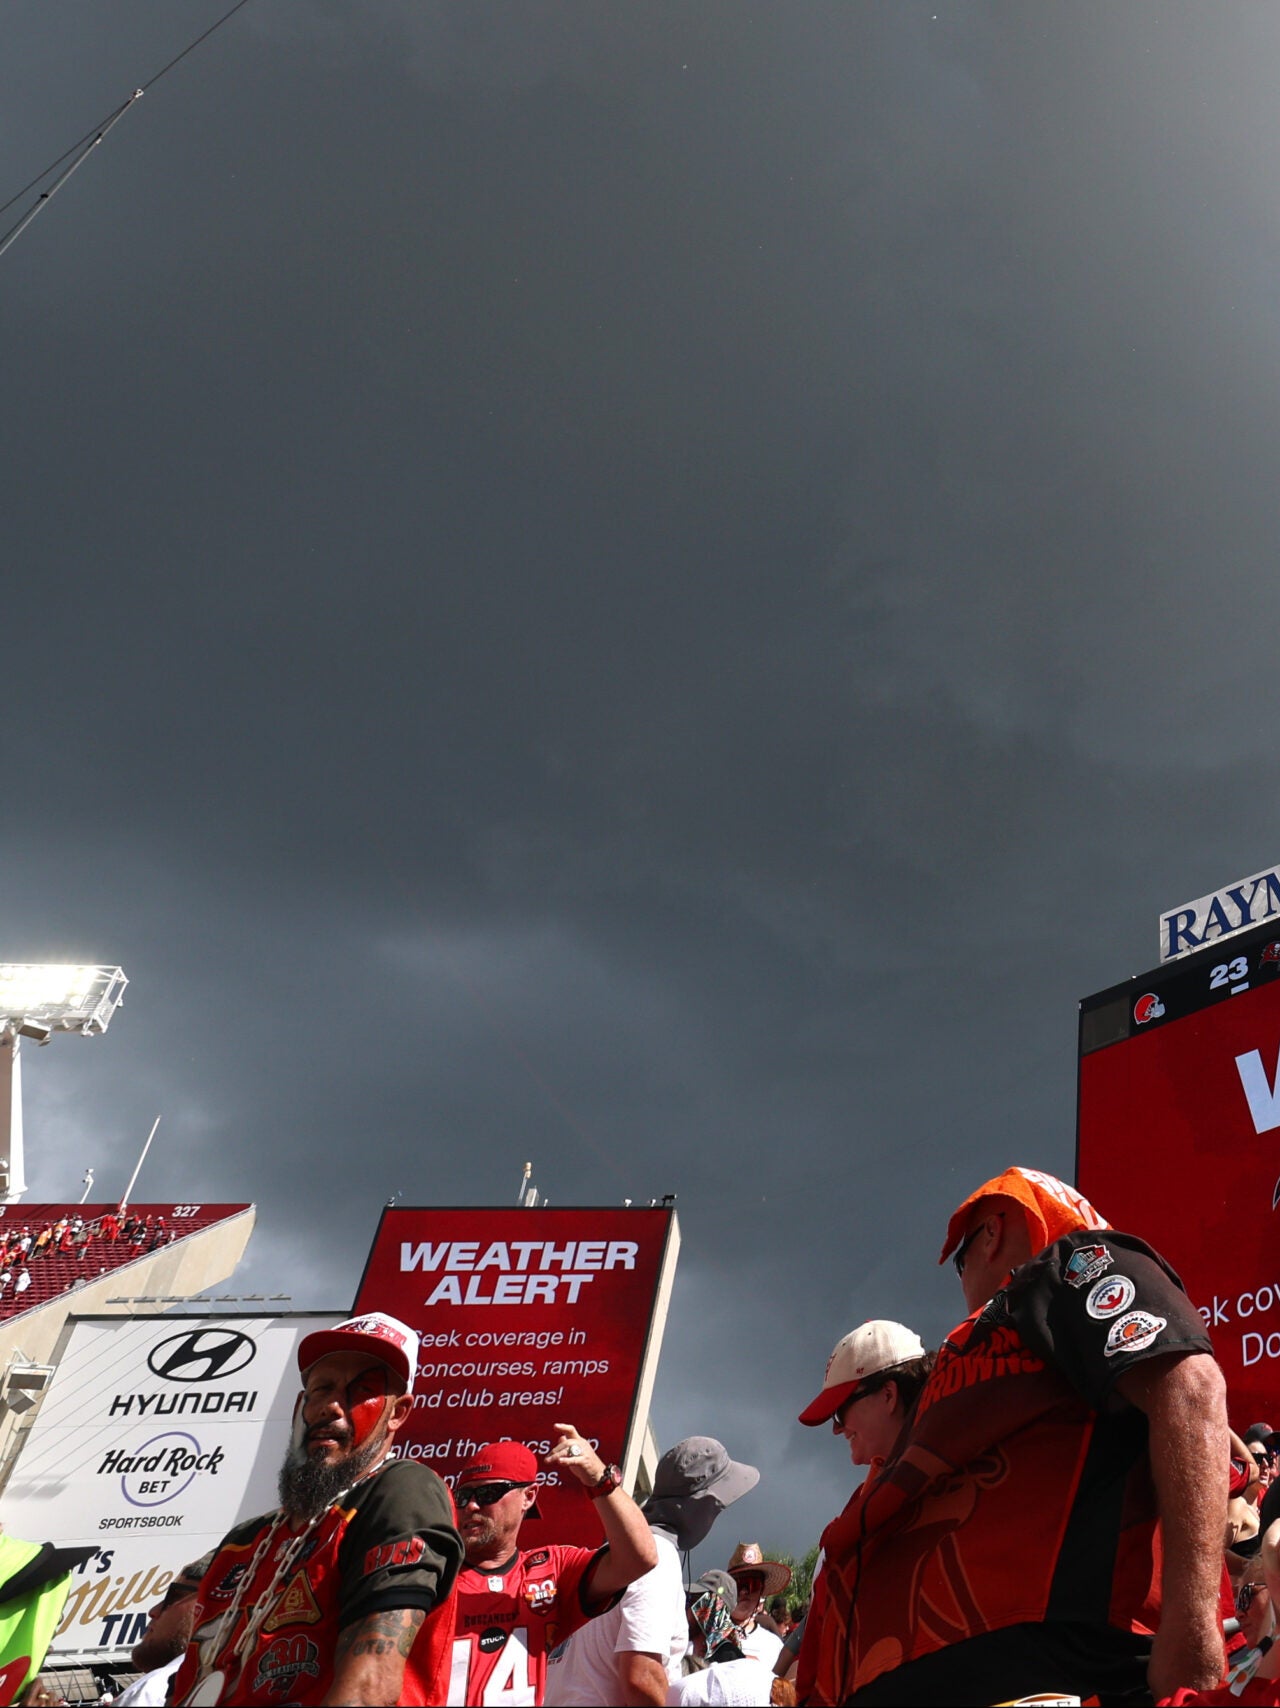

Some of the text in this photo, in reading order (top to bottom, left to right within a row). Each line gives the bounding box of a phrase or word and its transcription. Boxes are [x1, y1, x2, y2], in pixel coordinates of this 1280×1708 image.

[1209, 956, 1249, 990] 23
[171, 1205, 201, 1218] 327
[400, 1241, 639, 1272] WEATHER
[424, 1273, 594, 1306] ALERT
[1197, 1295, 1230, 1328] ek
[465, 1331, 564, 1350] coverage
[567, 1327, 587, 1345] in
[542, 1360, 609, 1379] ramps
[109, 1391, 258, 1417] HYUNDAI
[413, 1385, 564, 1409] nd club areas!
[97, 1445, 225, 1477] Hard Rock
[391, 1438, 452, 1460] nload
[138, 1480, 172, 1494] BET
[98, 1515, 184, 1530] SPORTSBOOK
[55, 1564, 174, 1636] Mille
[480, 1634, 505, 1646] STUCK
